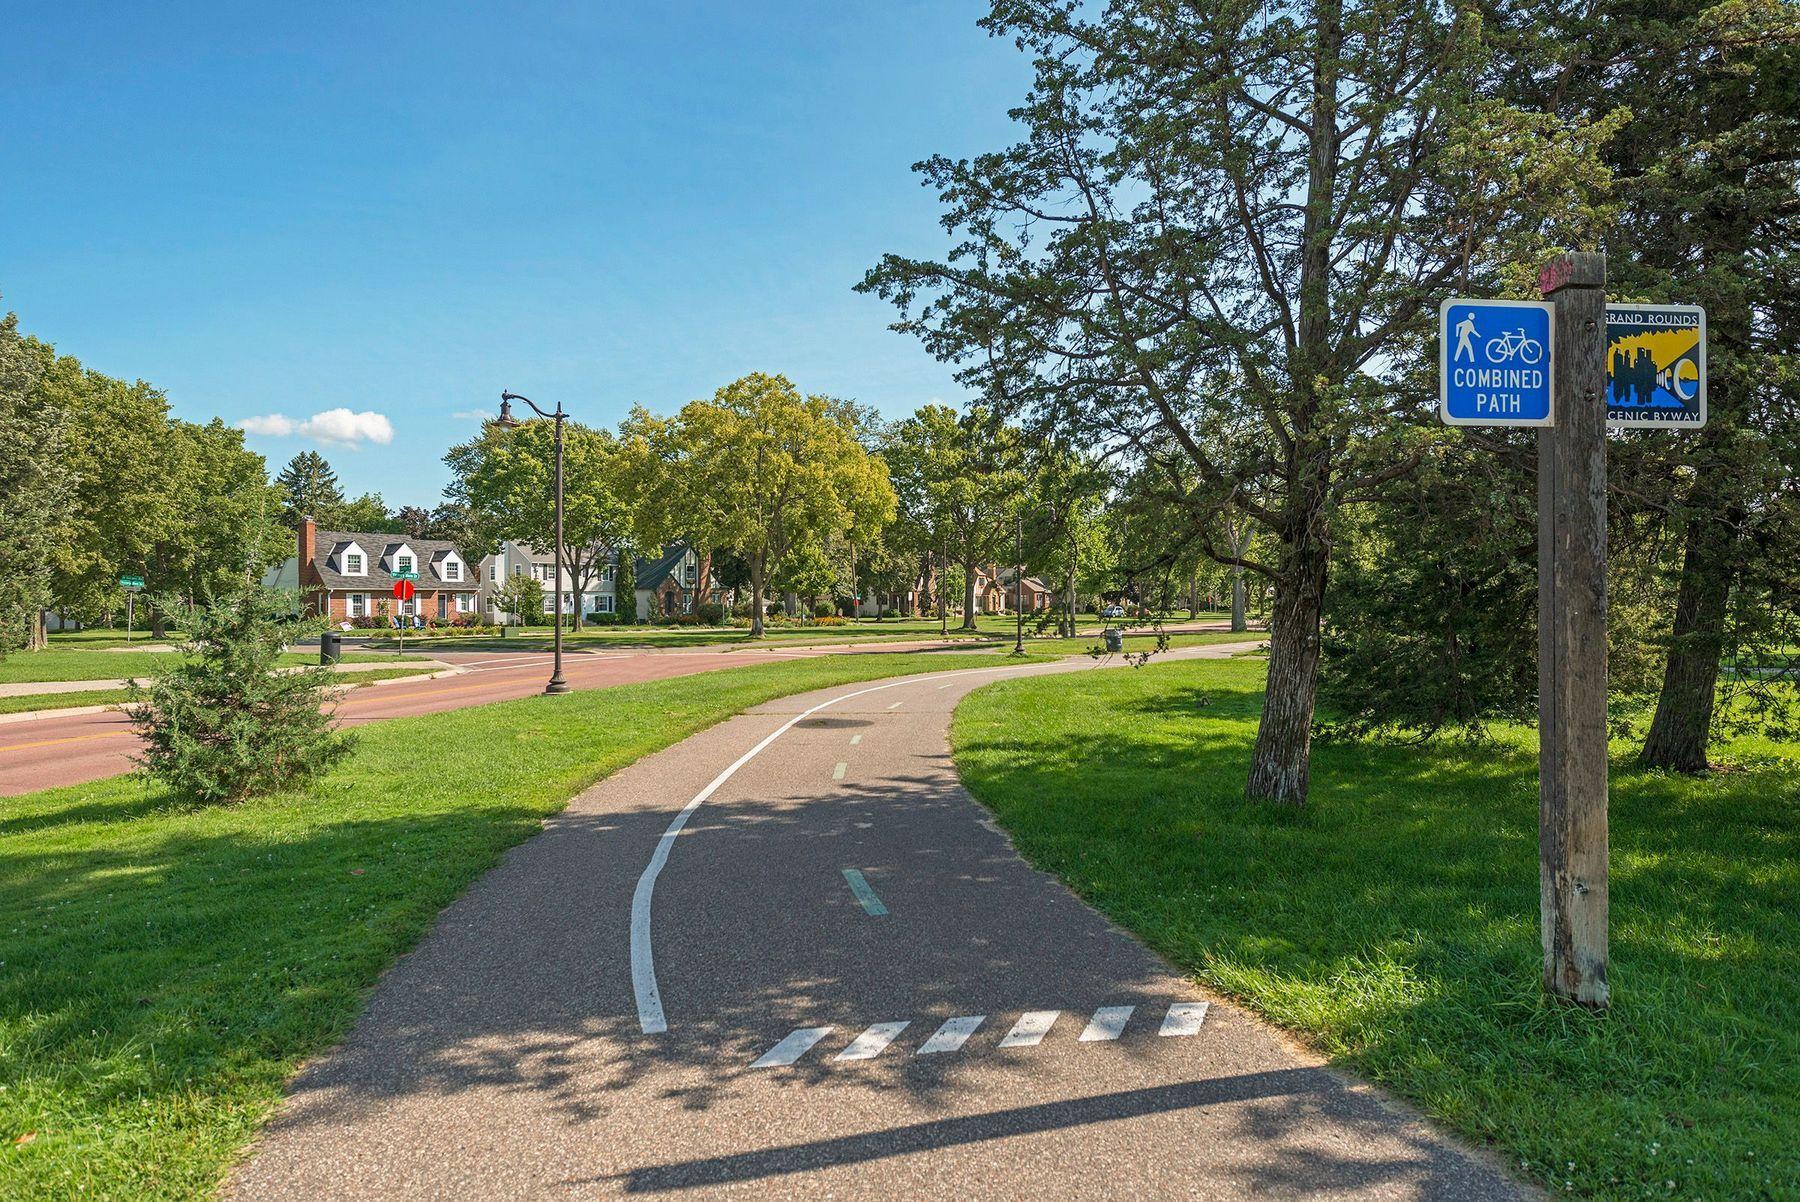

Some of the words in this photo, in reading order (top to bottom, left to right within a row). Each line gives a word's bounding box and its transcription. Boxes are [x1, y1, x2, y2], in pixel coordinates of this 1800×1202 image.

[1648, 314, 1698, 325] ROUNDS
[1454, 368, 1543, 389] COMBINED
[1477, 393, 1521, 413] PATH
[1607, 411, 1648, 421] CENIC
[1653, 412, 1699, 421] BYWAY
